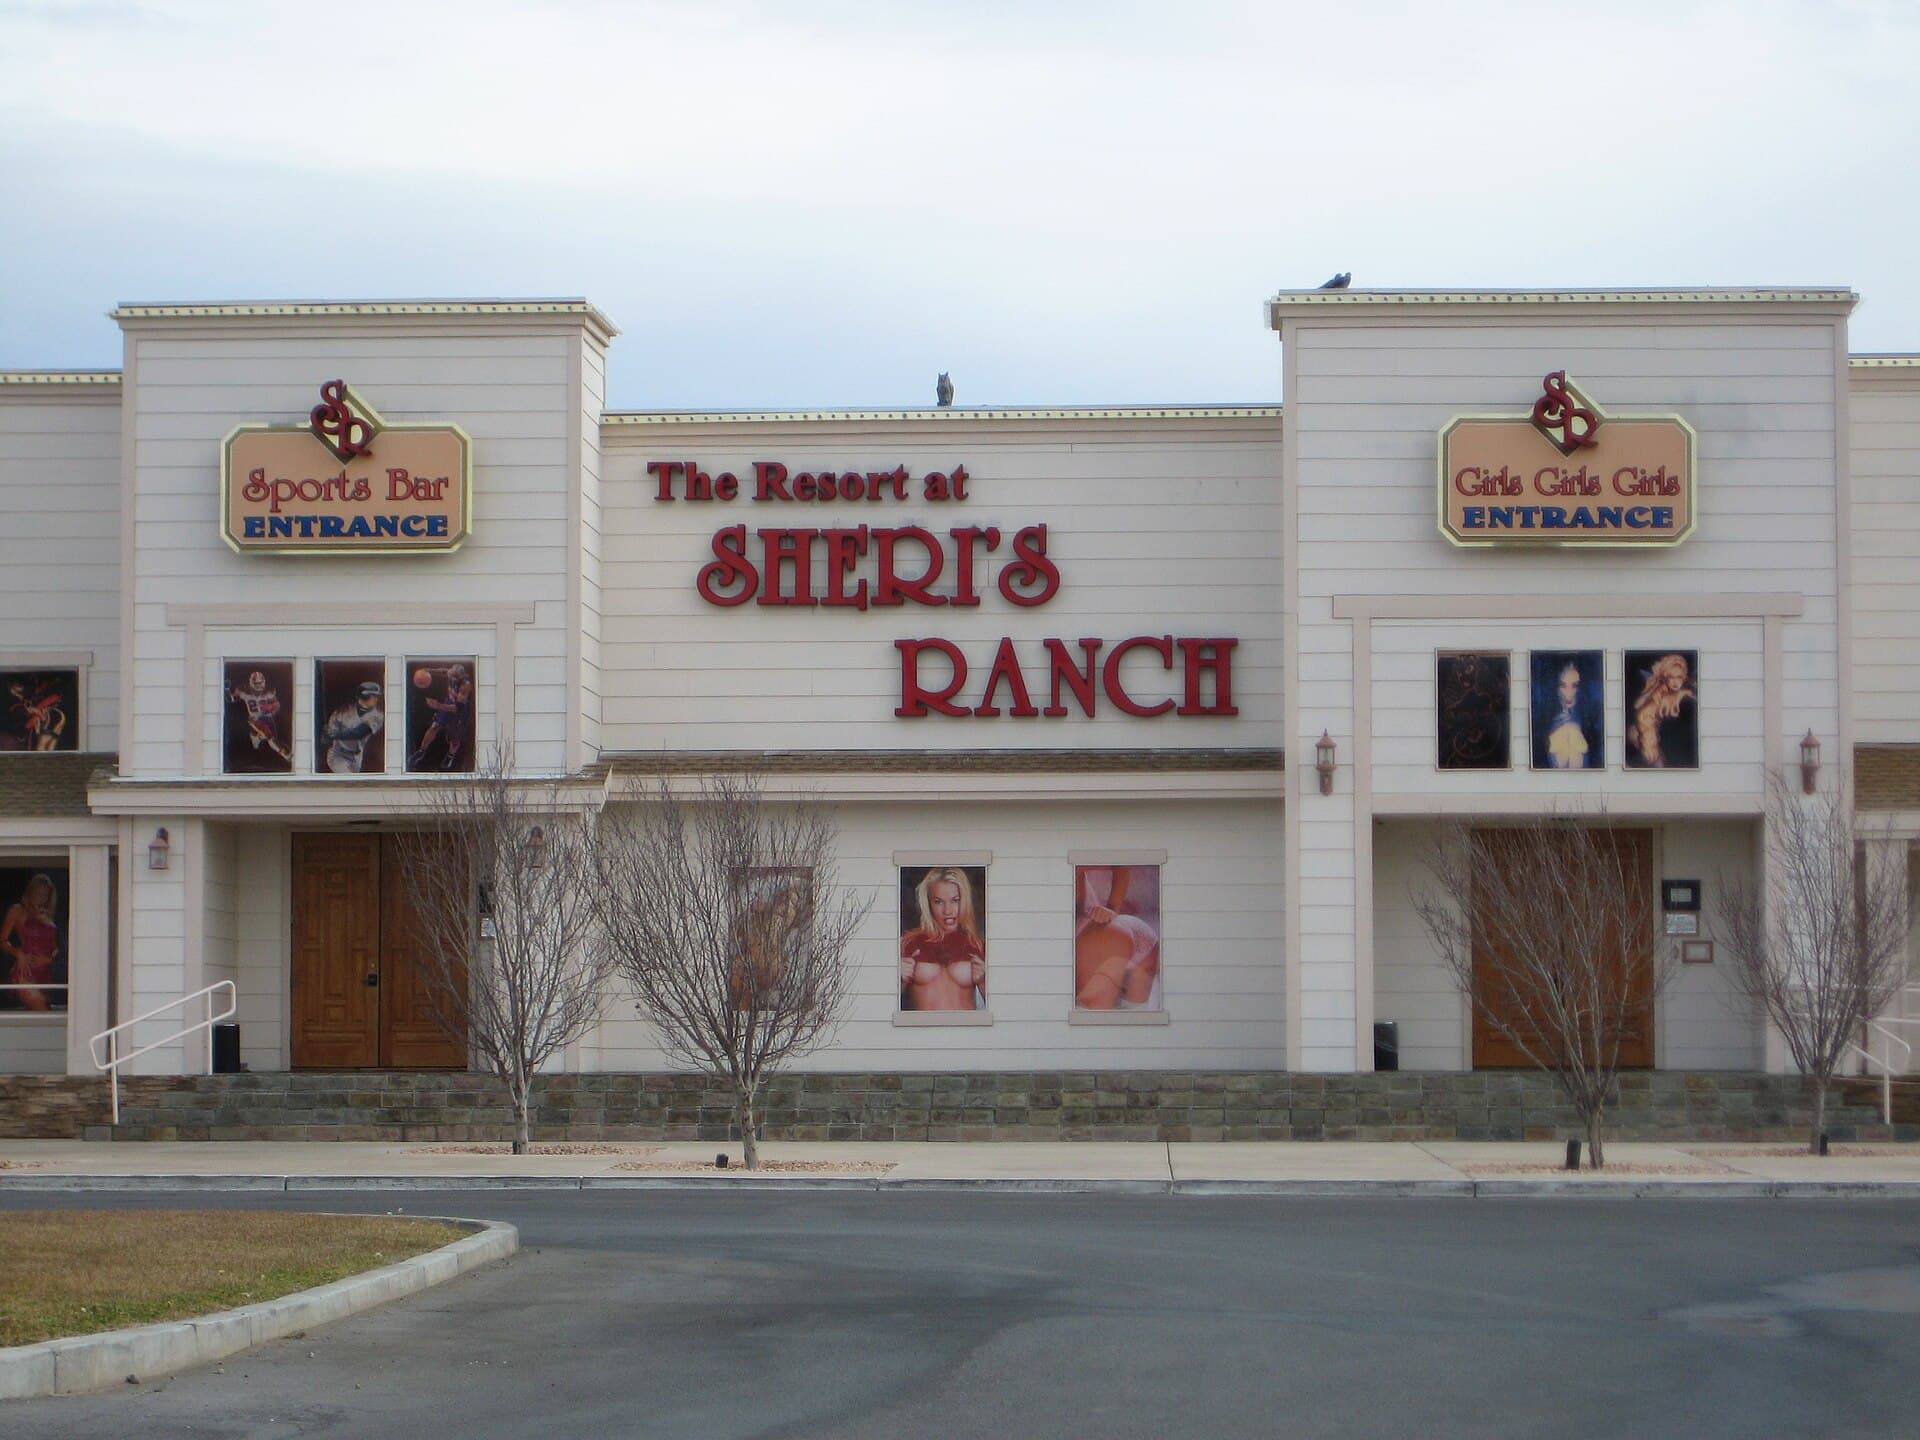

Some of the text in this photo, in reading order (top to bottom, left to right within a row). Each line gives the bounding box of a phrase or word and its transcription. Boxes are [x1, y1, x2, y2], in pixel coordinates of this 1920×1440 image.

[242, 467, 449, 513] Sports Bar
[646, 460, 971, 501] The Resort at
[1455, 465, 1681, 497] Girls Girls Girls
[243, 514, 448, 538] ENTRANCE
[1462, 505, 1674, 529] ENTRANCE
[696, 522, 1061, 611] SHERI'S
[893, 634, 1239, 719] RANCH
